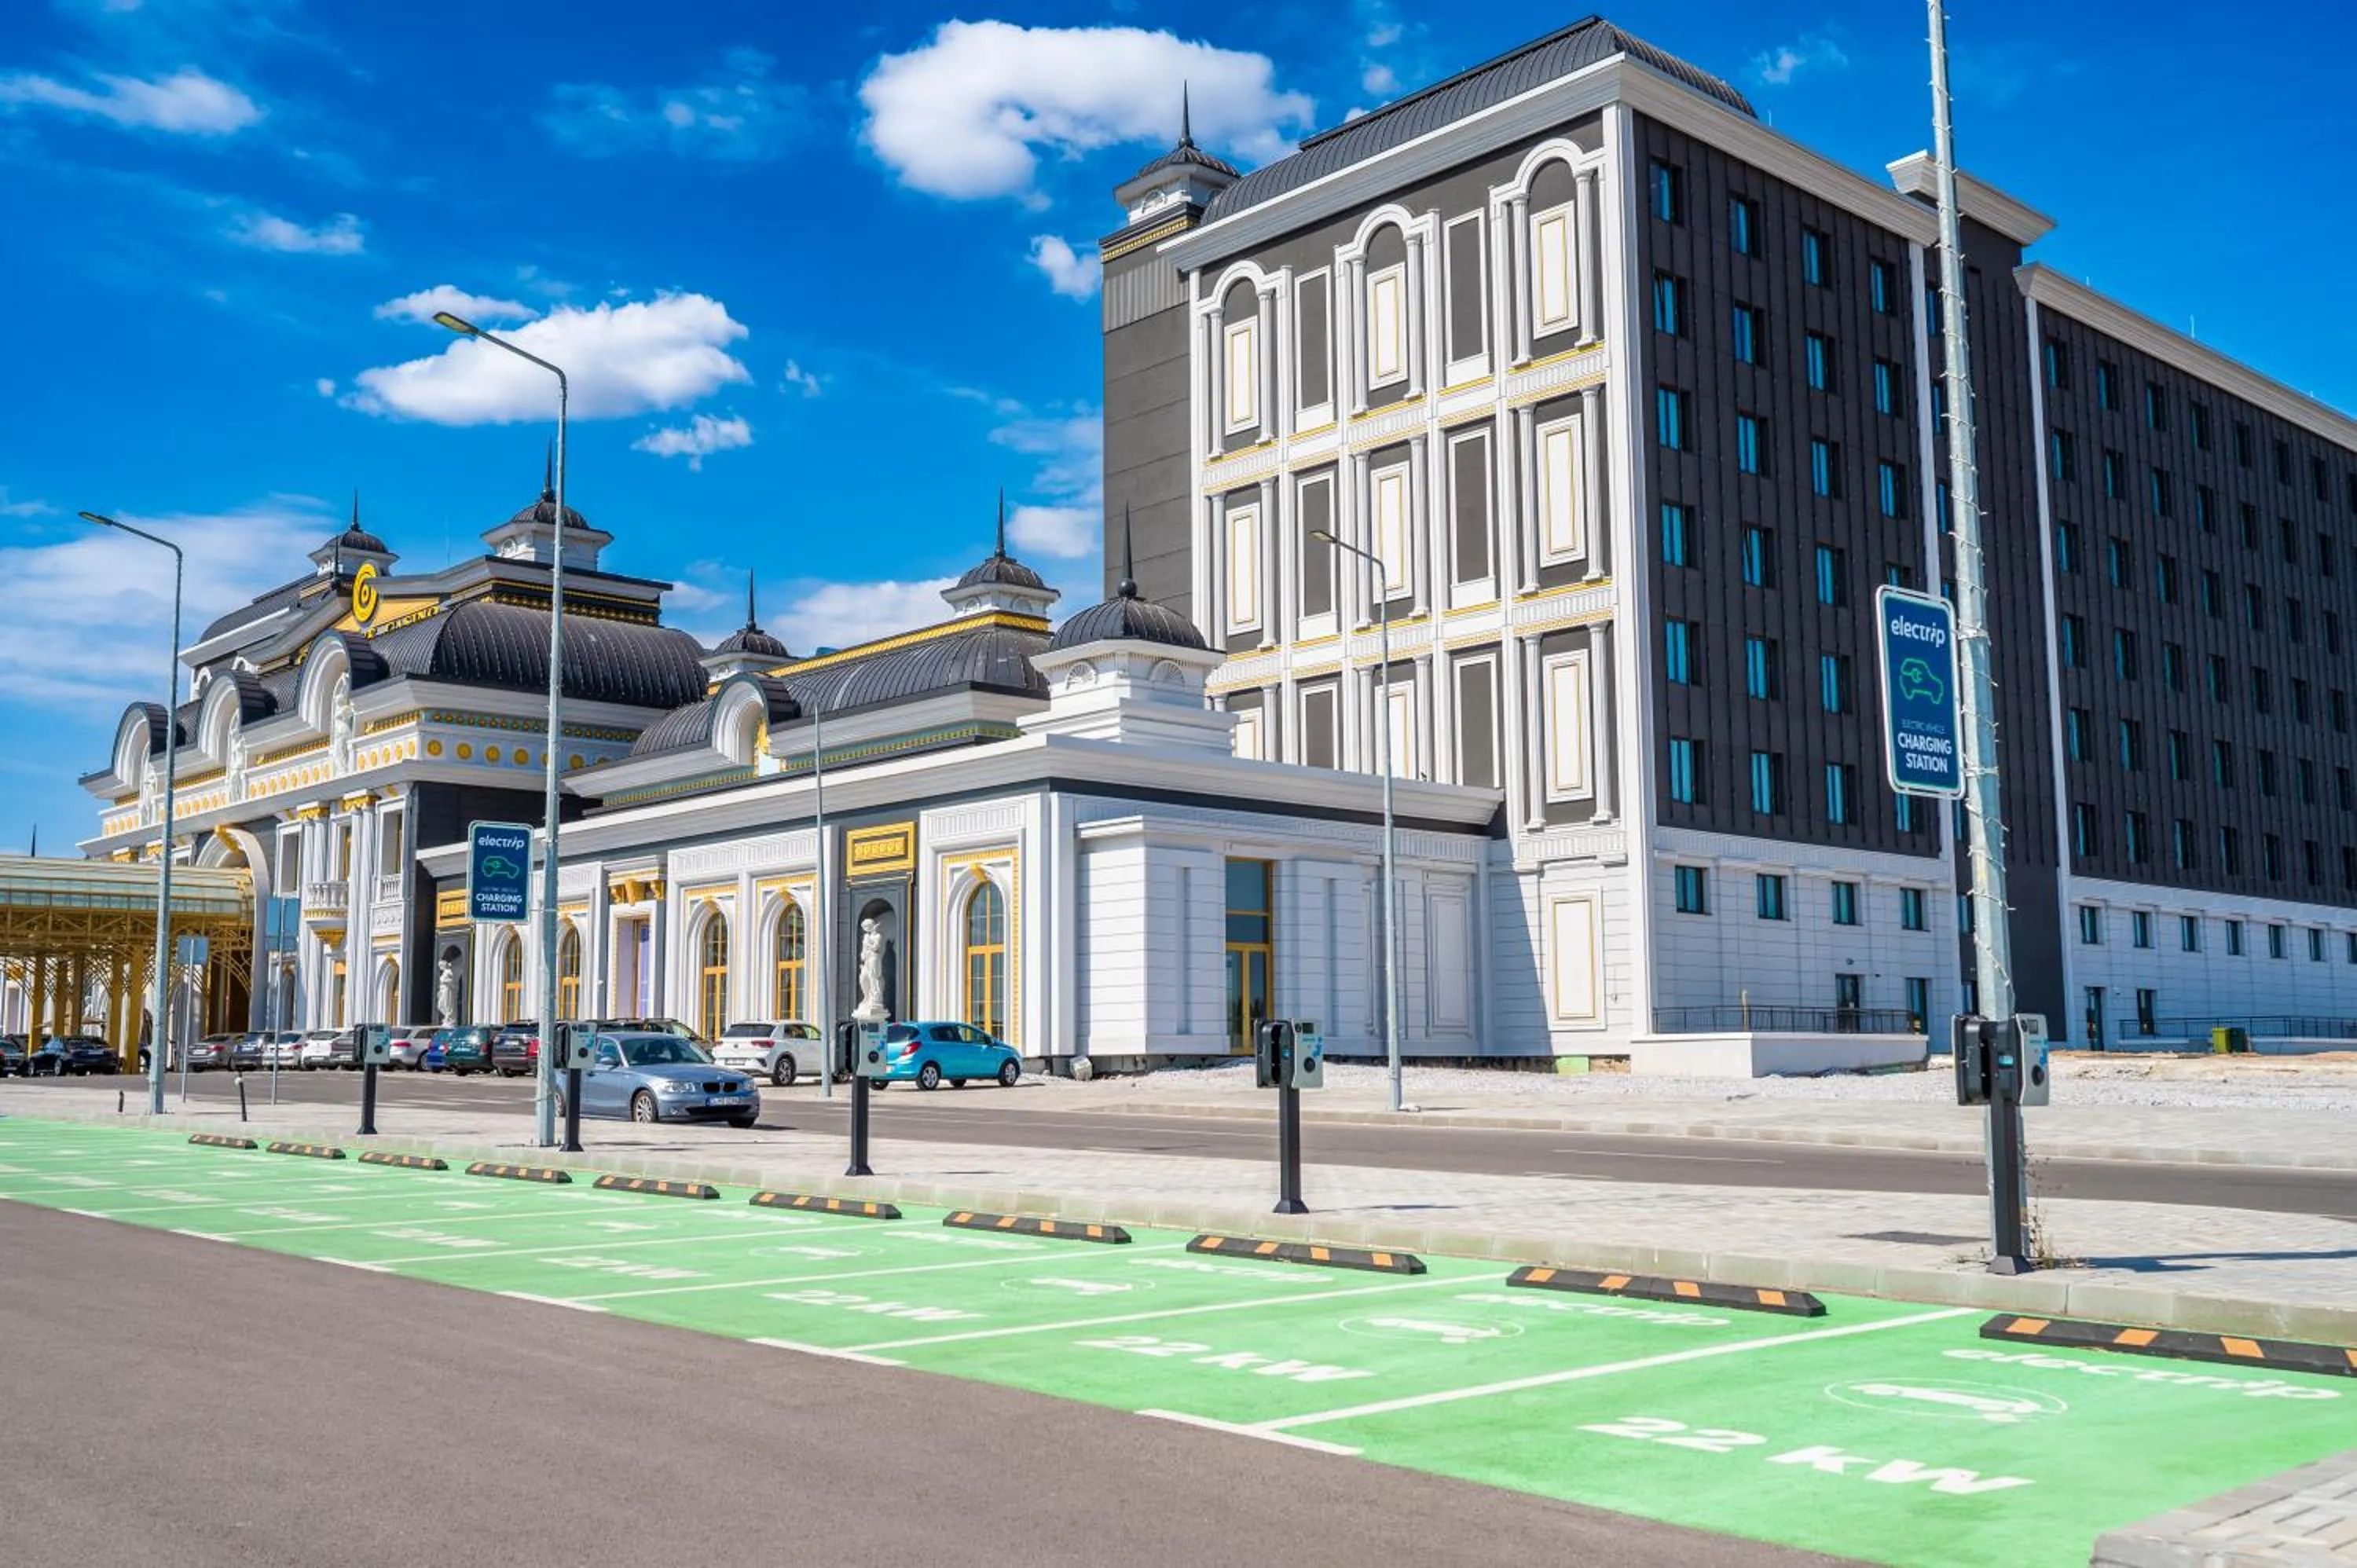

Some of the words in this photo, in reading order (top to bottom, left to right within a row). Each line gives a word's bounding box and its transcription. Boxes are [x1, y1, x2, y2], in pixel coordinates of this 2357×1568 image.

[1891, 616, 1946, 647] electrip
[1897, 732, 1952, 755] CHARGING
[1905, 752, 1948, 773] STATION
[478, 835, 525, 850] electrip
[475, 894, 522, 903] CHARGING
[481, 903, 517, 912] STATION
[1072, 1335, 1211, 1357] 22
[1942, 1348, 2344, 1399] electrip
[1576, 1416, 1767, 1453] 22
